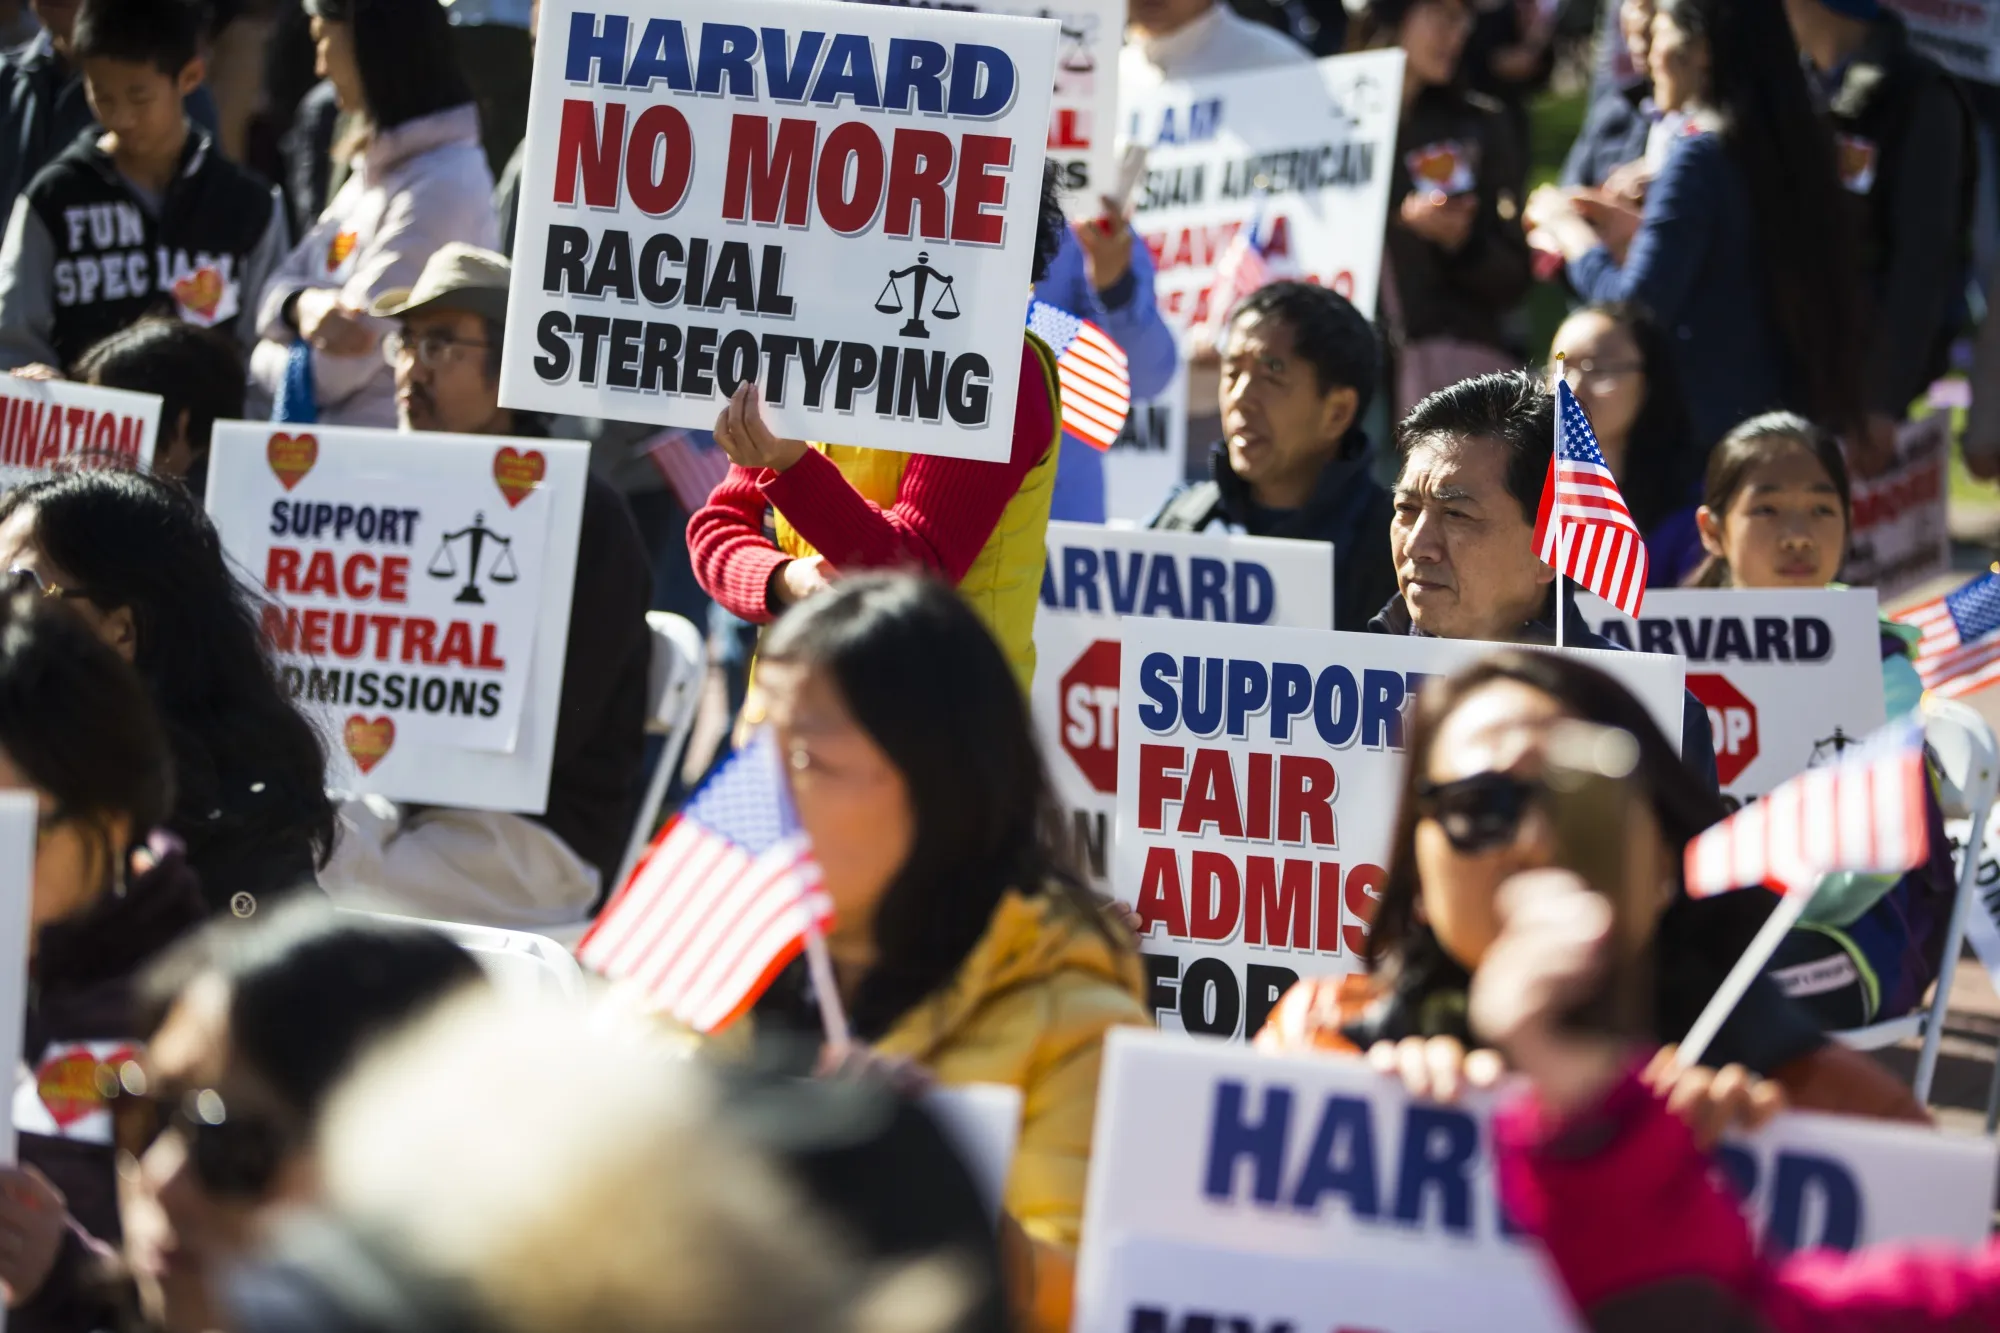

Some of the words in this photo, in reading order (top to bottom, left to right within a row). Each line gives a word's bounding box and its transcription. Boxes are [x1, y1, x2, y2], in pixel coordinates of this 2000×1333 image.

[565, 12, 1016, 120] HARVARD
[553, 98, 696, 217] NO
[721, 113, 1012, 244] MORE
[64, 202, 143, 251] FUN
[543, 224, 795, 318] RACIAL
[533, 310, 991, 427] STEREOTYPING
[270, 499, 419, 546] SUPPORT
[264, 547, 411, 602] RACE
[261, 604, 505, 670] NEUTRAL
[1138, 743, 1340, 849] FAIR
